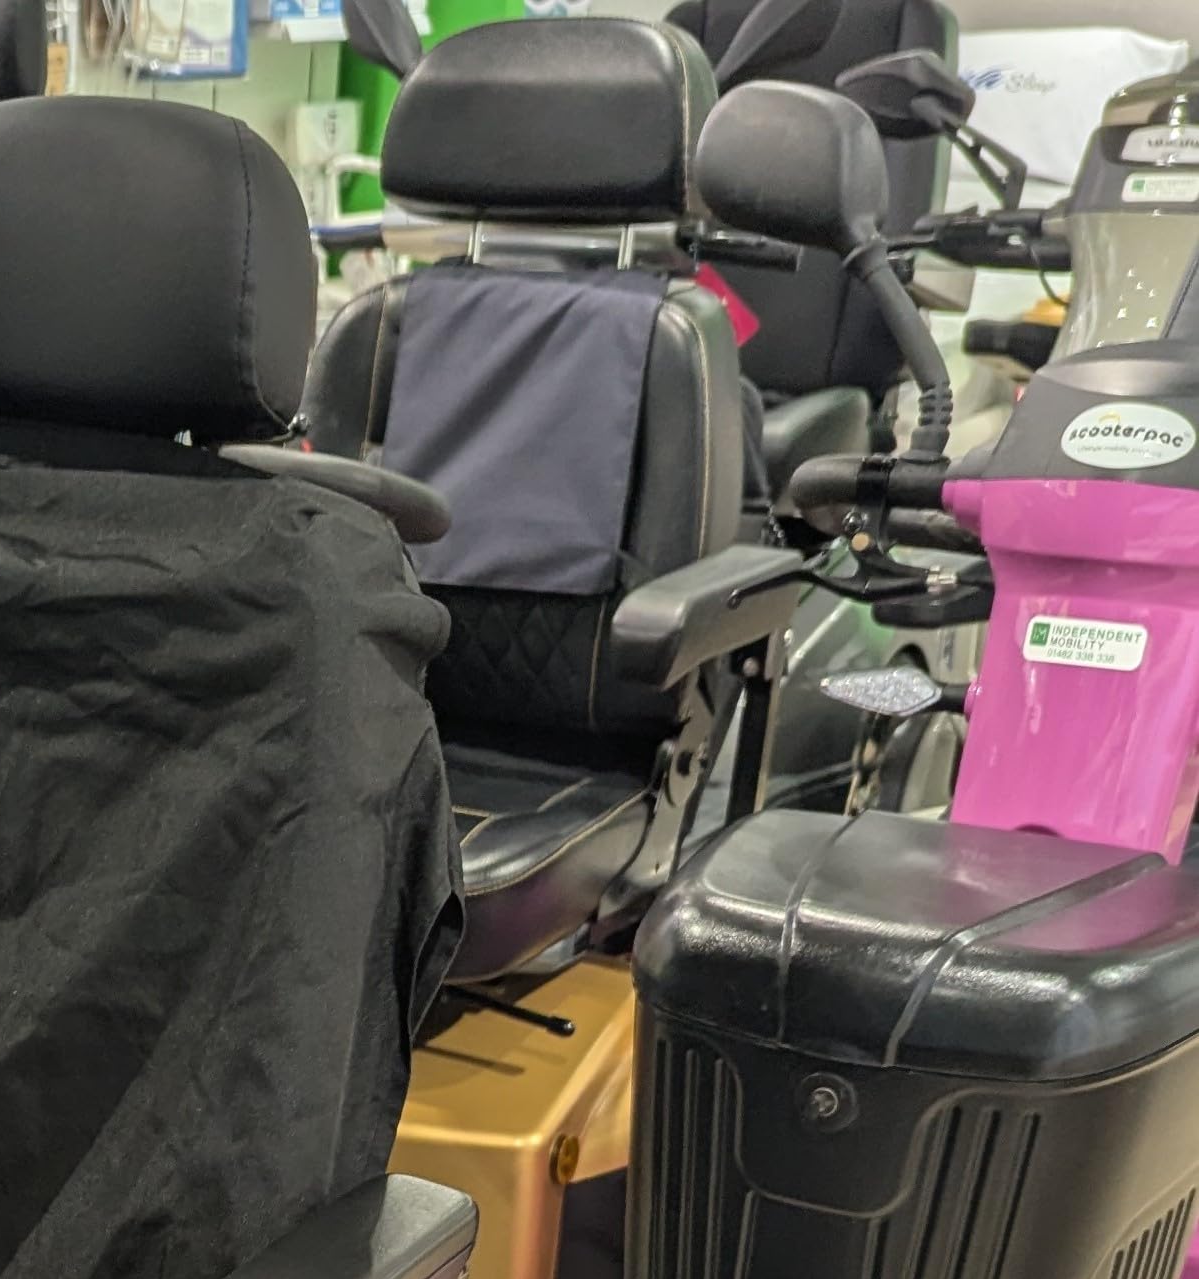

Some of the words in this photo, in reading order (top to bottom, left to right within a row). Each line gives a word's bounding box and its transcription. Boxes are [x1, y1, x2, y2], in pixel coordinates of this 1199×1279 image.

[1069, 424, 1184, 448] scooterpac
[1052, 625, 1142, 643] INDEPENDENT
[1050, 637, 1104, 650] MOBILITY
[1047, 648, 1073, 660] 01482
